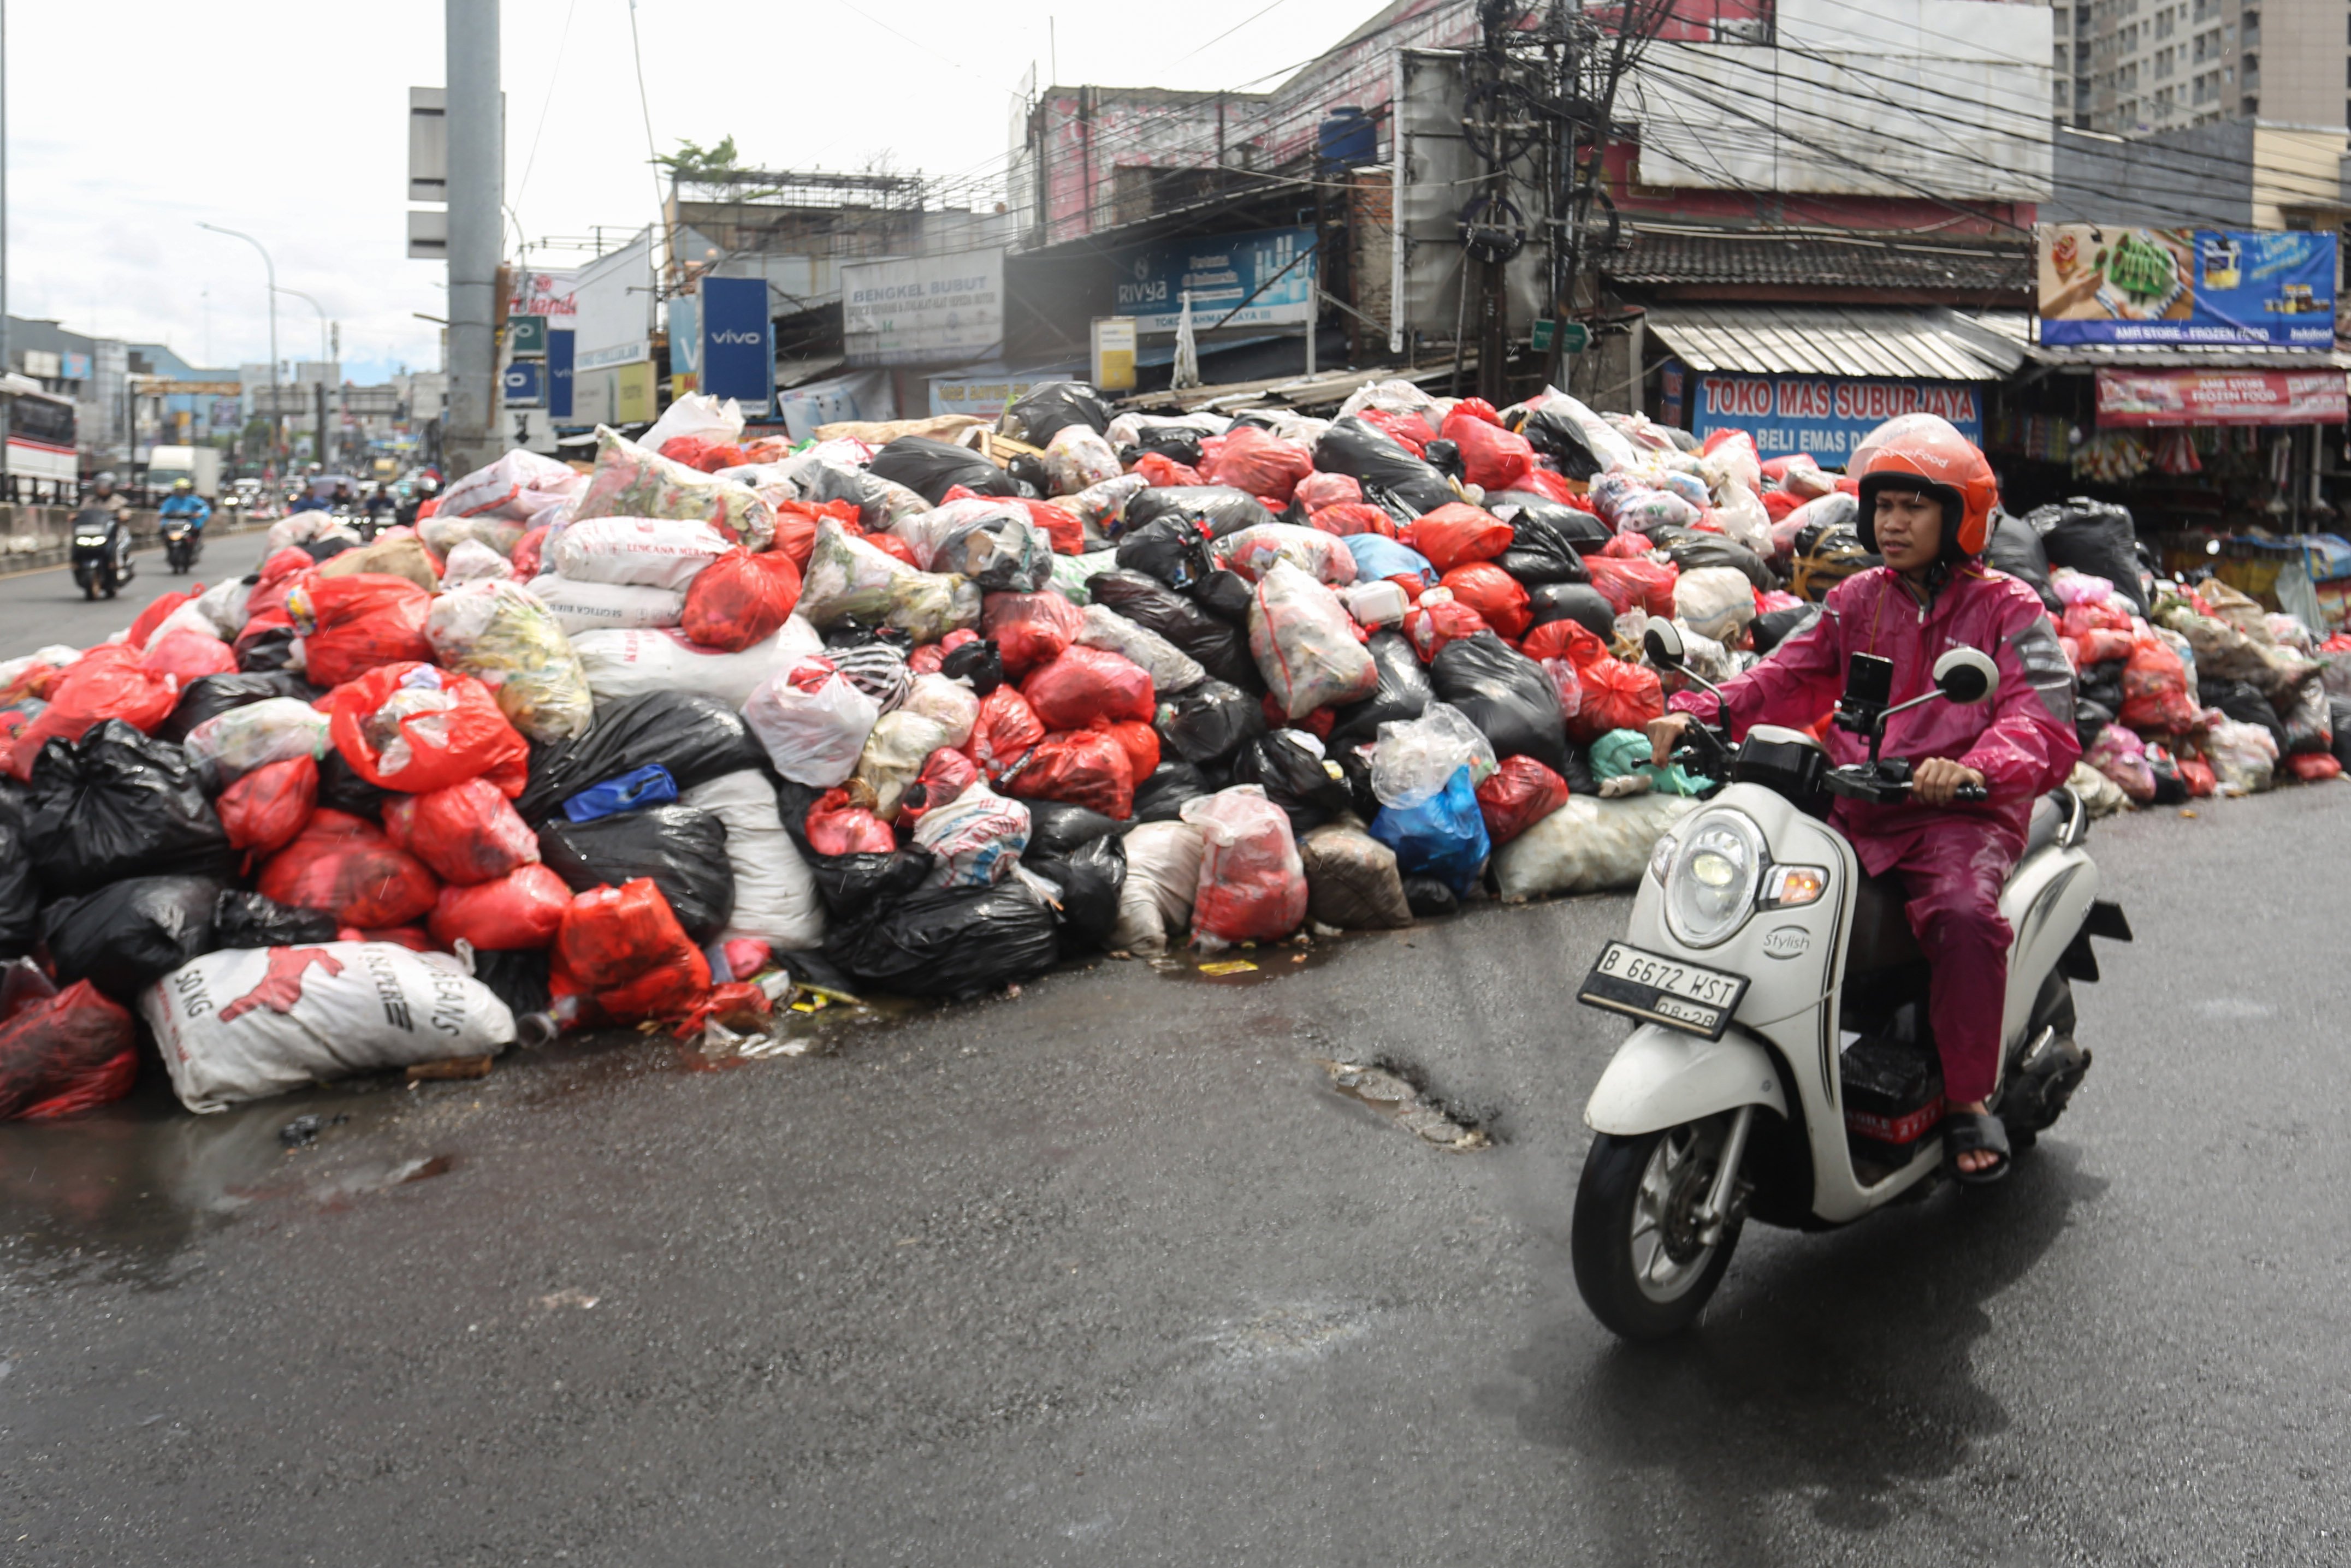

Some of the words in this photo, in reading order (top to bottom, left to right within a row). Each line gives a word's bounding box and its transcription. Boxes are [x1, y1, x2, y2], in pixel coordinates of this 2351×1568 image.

[853, 283, 925, 302] BENGKEL
[931, 276, 987, 294] BUBUT
[712, 329, 761, 345] vivo
[2143, 327, 2182, 340] STORE
[2189, 327, 2234, 341] FROZEN
[1704, 378, 1772, 417] TOKO
[1778, 379, 1831, 419] MAS
[2242, 390, 2277, 402] FOOD
[1757, 426, 1794, 450] BELI
[1799, 428, 1846, 453] EMAS
[626, 543, 674, 555] LENCANA
[577, 606, 622, 618] SEGITIGA
[1763, 934, 1810, 952] Stylish
[175, 970, 203, 993] 50
[1603, 949, 1620, 971] B
[1628, 958, 1684, 990] 6672
[1689, 973, 1734, 1005] WST
[182, 988, 213, 1018] KG
